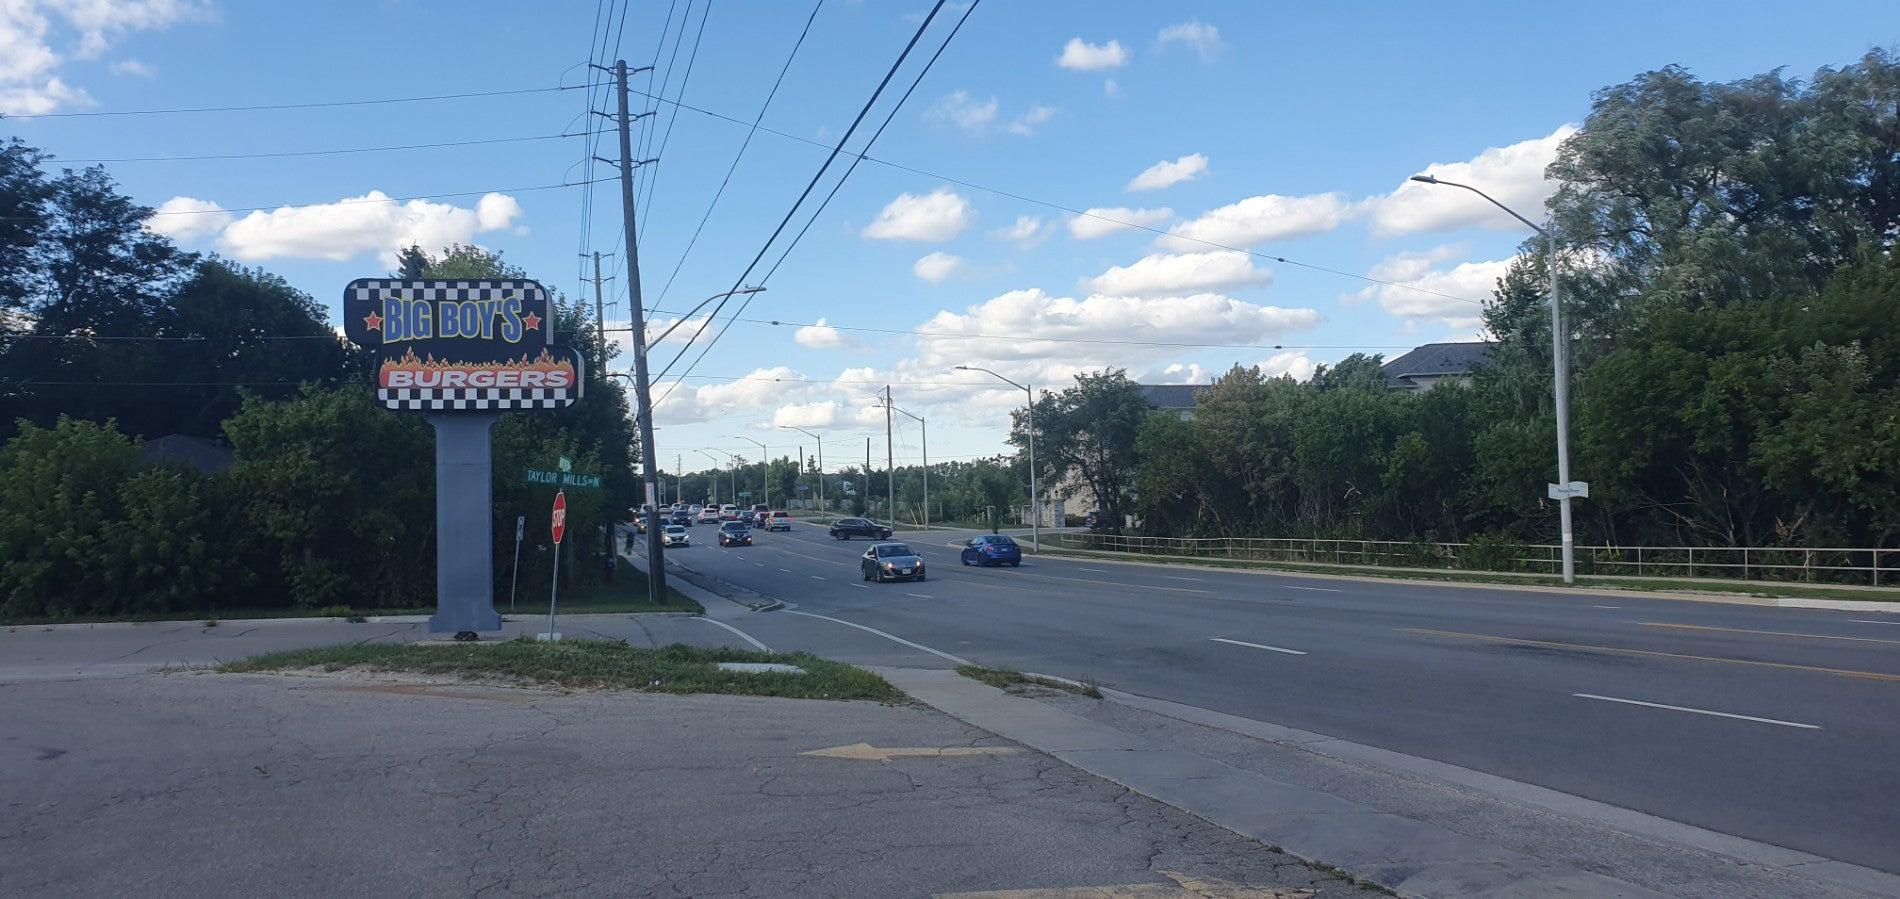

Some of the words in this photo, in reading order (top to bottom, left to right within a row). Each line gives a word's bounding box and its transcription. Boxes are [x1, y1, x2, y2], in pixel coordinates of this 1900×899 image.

[382, 296, 433, 344] BIG
[439, 296, 522, 344] BOY'S
[388, 371, 568, 388] BURGERS
[527, 470, 557, 484] TAYLOR
[563, 474, 587, 487] MILLS
[593, 477, 600, 488] N
[554, 509, 565, 528] STOP
